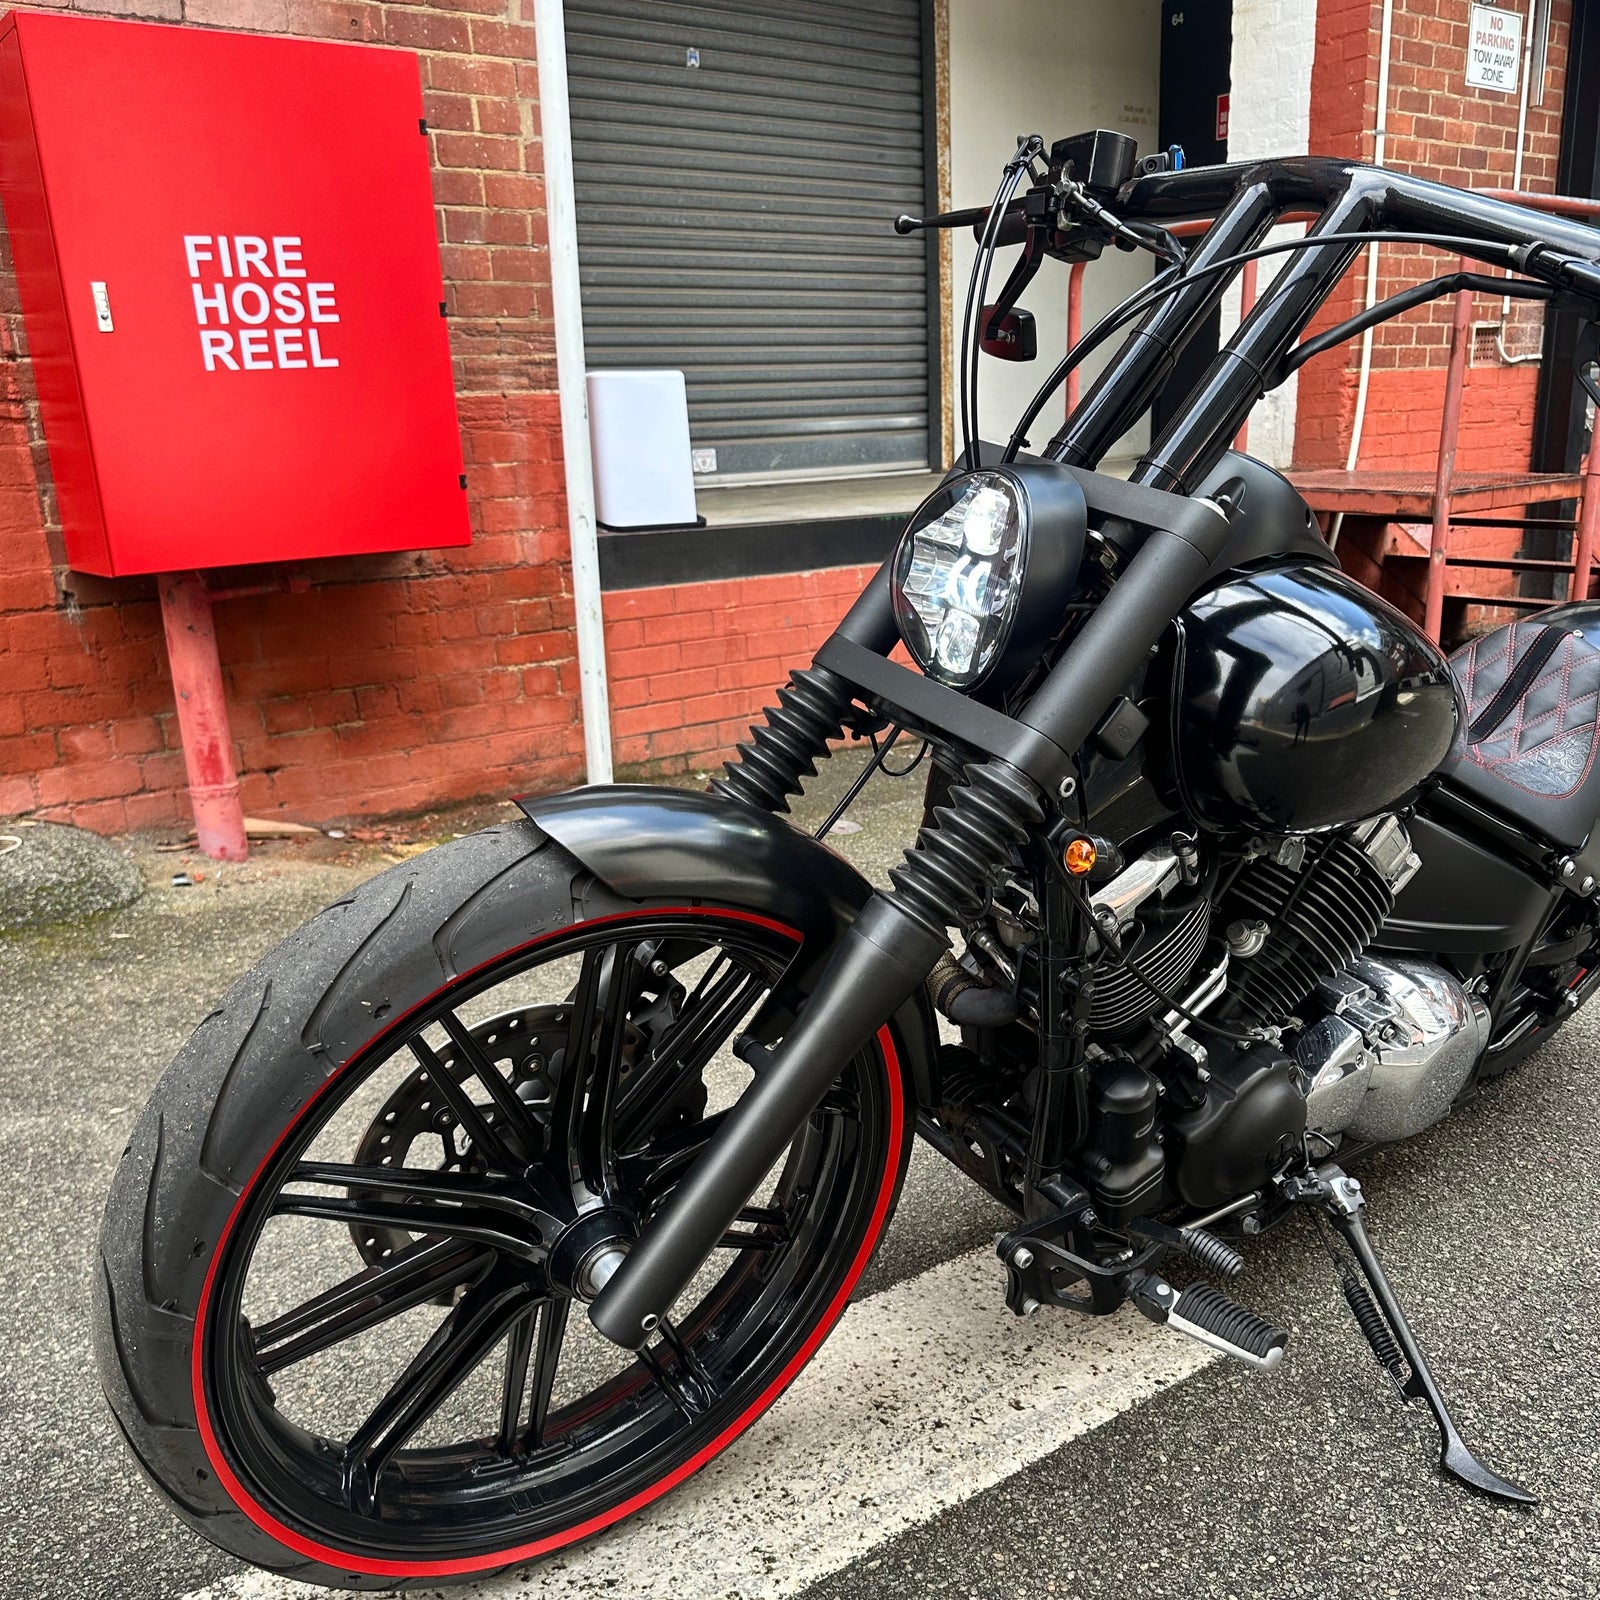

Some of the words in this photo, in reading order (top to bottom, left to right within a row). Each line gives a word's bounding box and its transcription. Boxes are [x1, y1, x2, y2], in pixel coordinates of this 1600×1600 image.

[1171, 12, 1184, 26] 64
[1490, 16, 1503, 31] NO
[1476, 31, 1515, 51] PARKING
[1473, 49, 1492, 64] TOW
[1493, 54, 1515, 68] AWAY
[1481, 68, 1504, 83] ZONE
[183, 235, 307, 278] FIRE
[191, 282, 340, 325] HOSE
[199, 328, 339, 372] REEL
